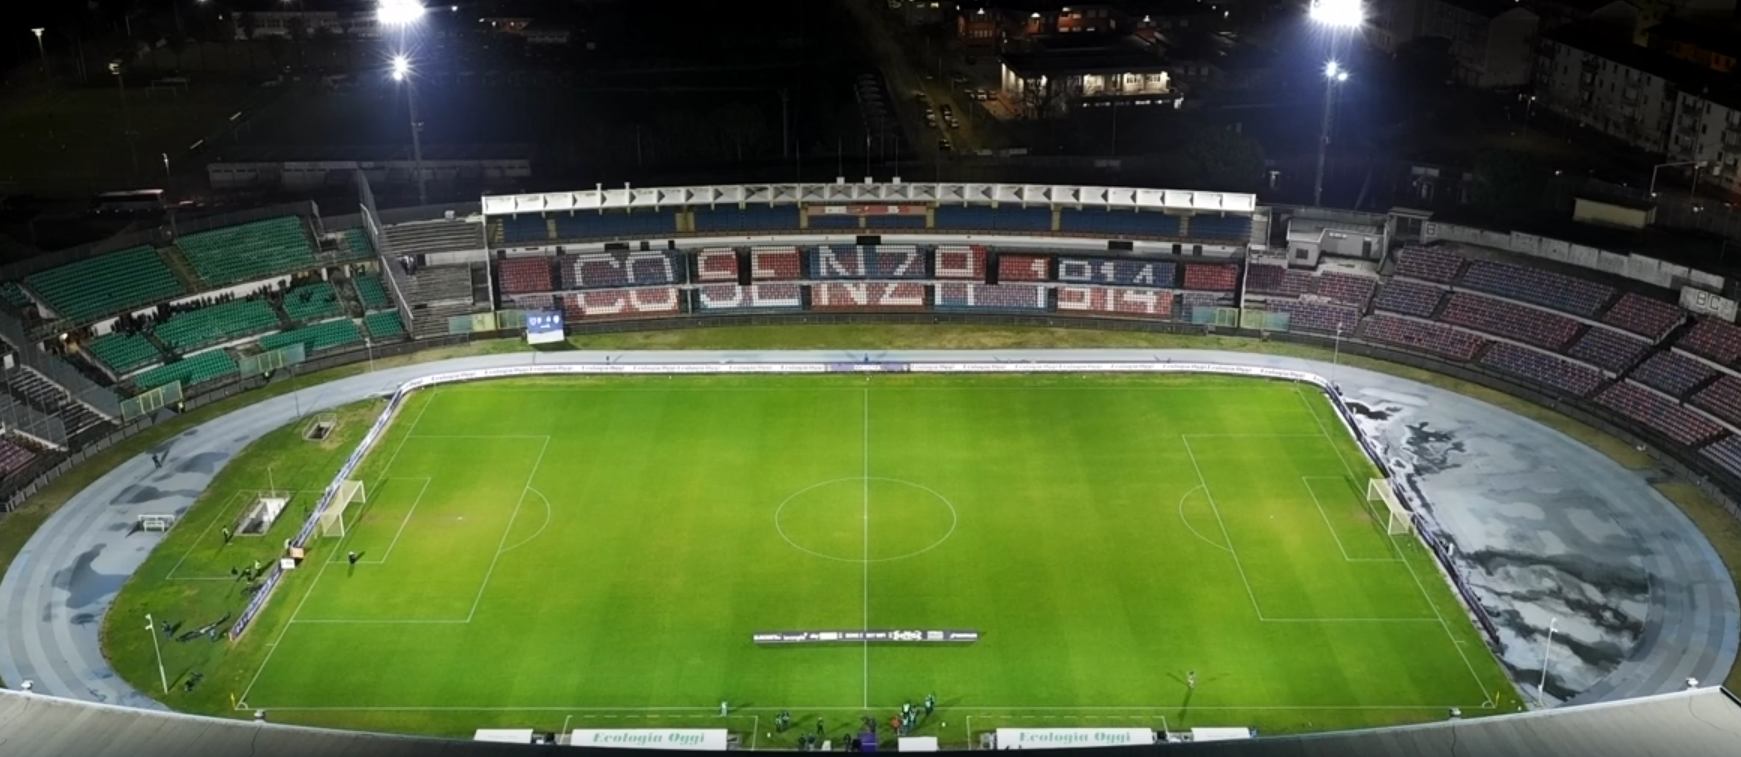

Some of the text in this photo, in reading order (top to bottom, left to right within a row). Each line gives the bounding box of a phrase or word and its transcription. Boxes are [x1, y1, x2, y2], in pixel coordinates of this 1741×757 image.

[573, 244, 1157, 316] COSENZA 1814
[593, 733, 705, 746] Ecologia Oggi
[1019, 732, 1131, 744] Ecologia Oggi
